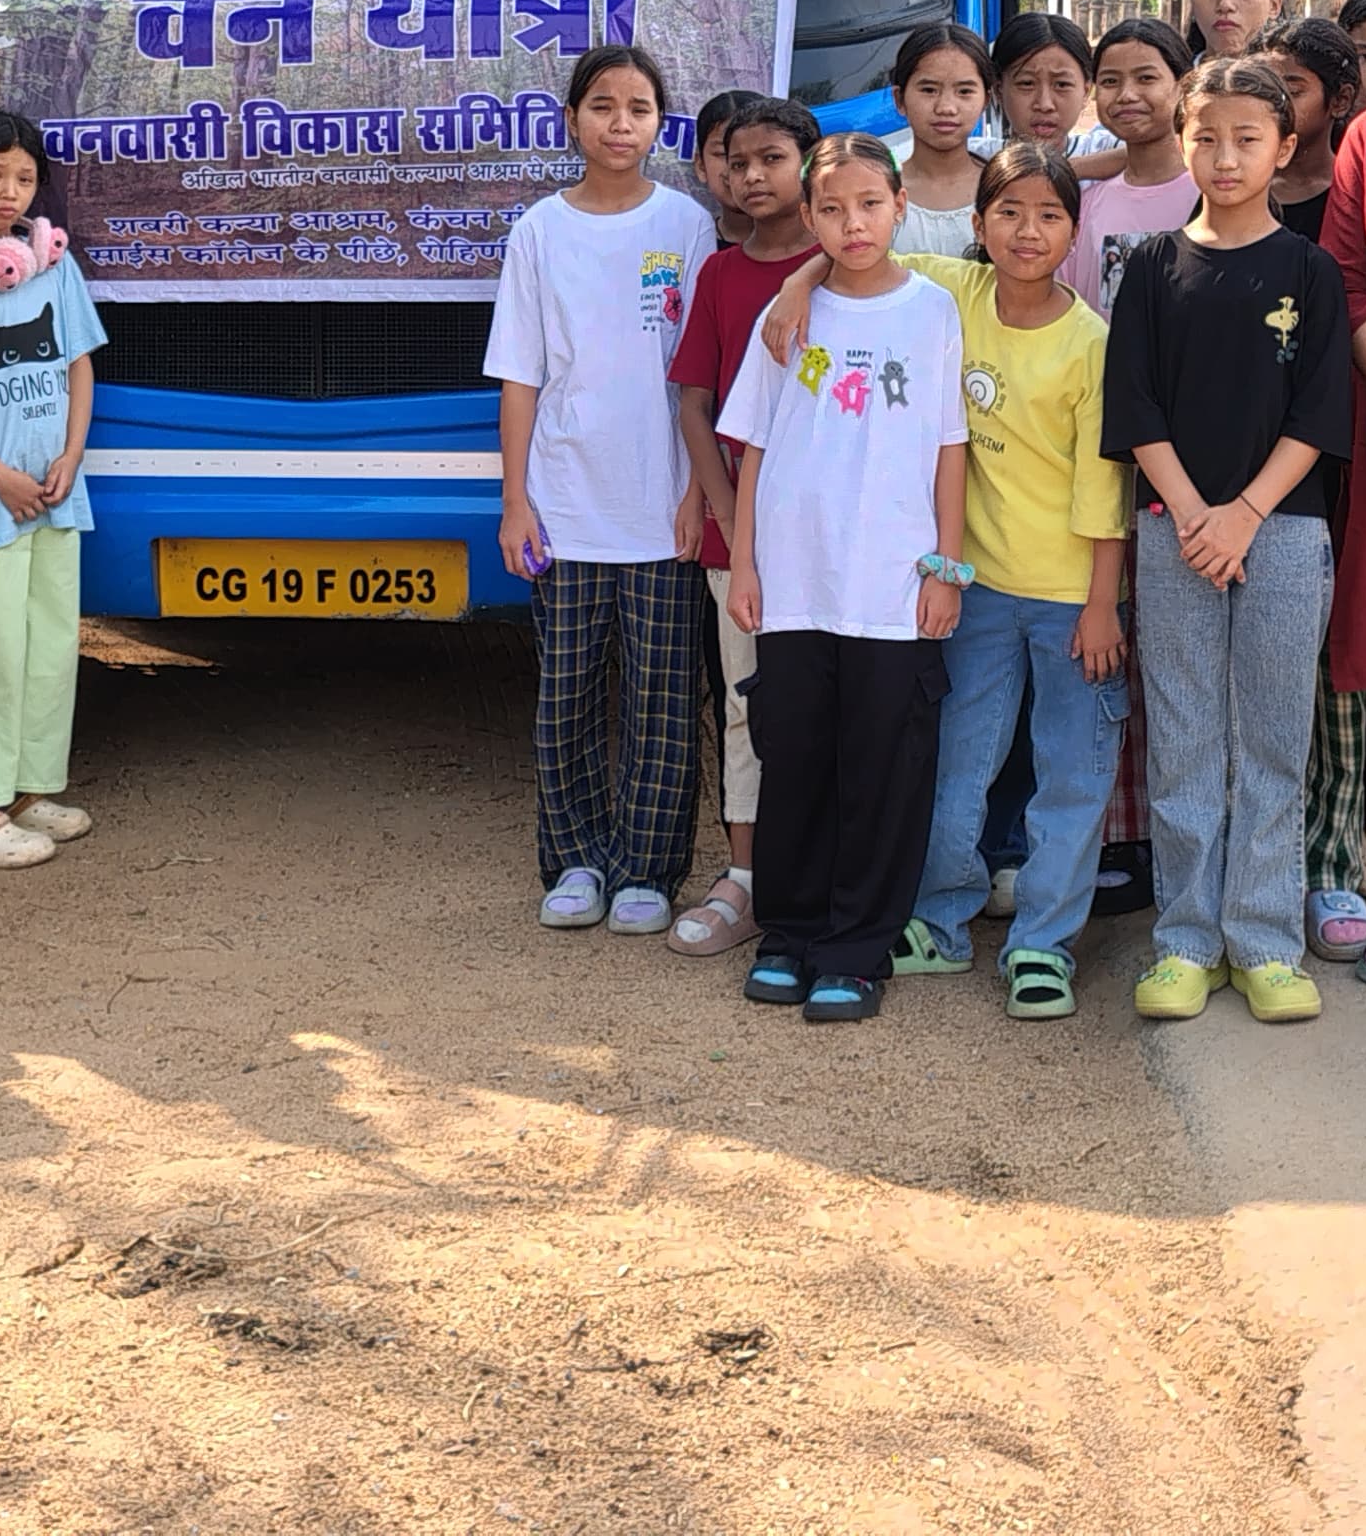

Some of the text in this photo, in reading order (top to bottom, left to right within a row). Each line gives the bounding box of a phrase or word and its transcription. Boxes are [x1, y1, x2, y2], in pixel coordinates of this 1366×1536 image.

[40, 101, 228, 166] वनवासी
[241, 97, 406, 161] विकास
[415, 92, 567, 156] समिति
[182, 166, 246, 189] अखिल
[251, 162, 316, 188] भारतीय
[320, 159, 389, 185] वनवासी
[391, 163, 465, 183] कल्याण
[468, 161, 524, 182] आश्रम
[526, 155, 545, 181] से
[105, 211, 191, 237] शबरी
[197, 213, 283, 234] कन्या
[290, 209, 398, 233] आश्रम,
[405, 204, 494, 230] कंचन
[178, 241, 287, 265] कॉलेज
[290, 237, 330, 264] के
[335, 236, 409, 267] पीछे,
[195, 567, 437, 604] CG 19 F 0253
